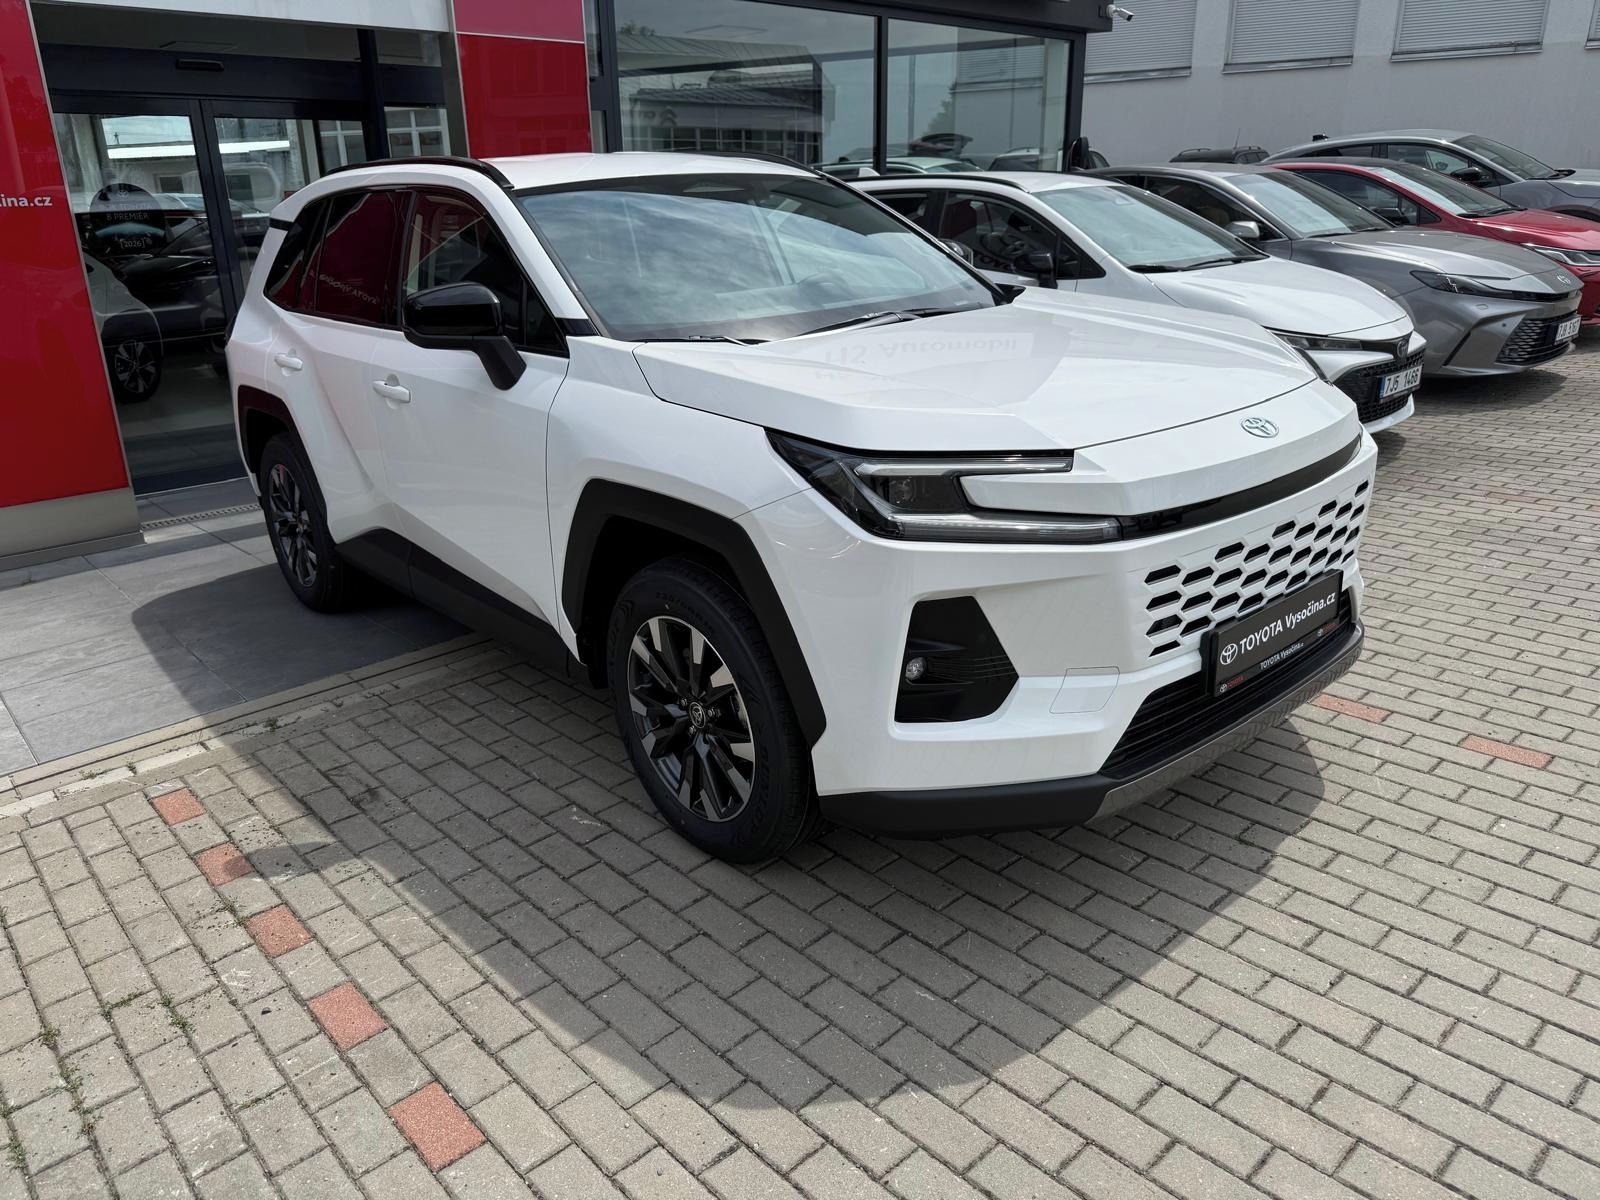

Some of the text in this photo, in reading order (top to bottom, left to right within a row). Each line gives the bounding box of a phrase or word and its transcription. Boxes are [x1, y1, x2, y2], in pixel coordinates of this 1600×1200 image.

[0, 193, 53, 207] ina.cz
[1239, 591, 1336, 655] TOYOTA Vysočina.cz
[1260, 653, 1281, 670] TOYOTA
